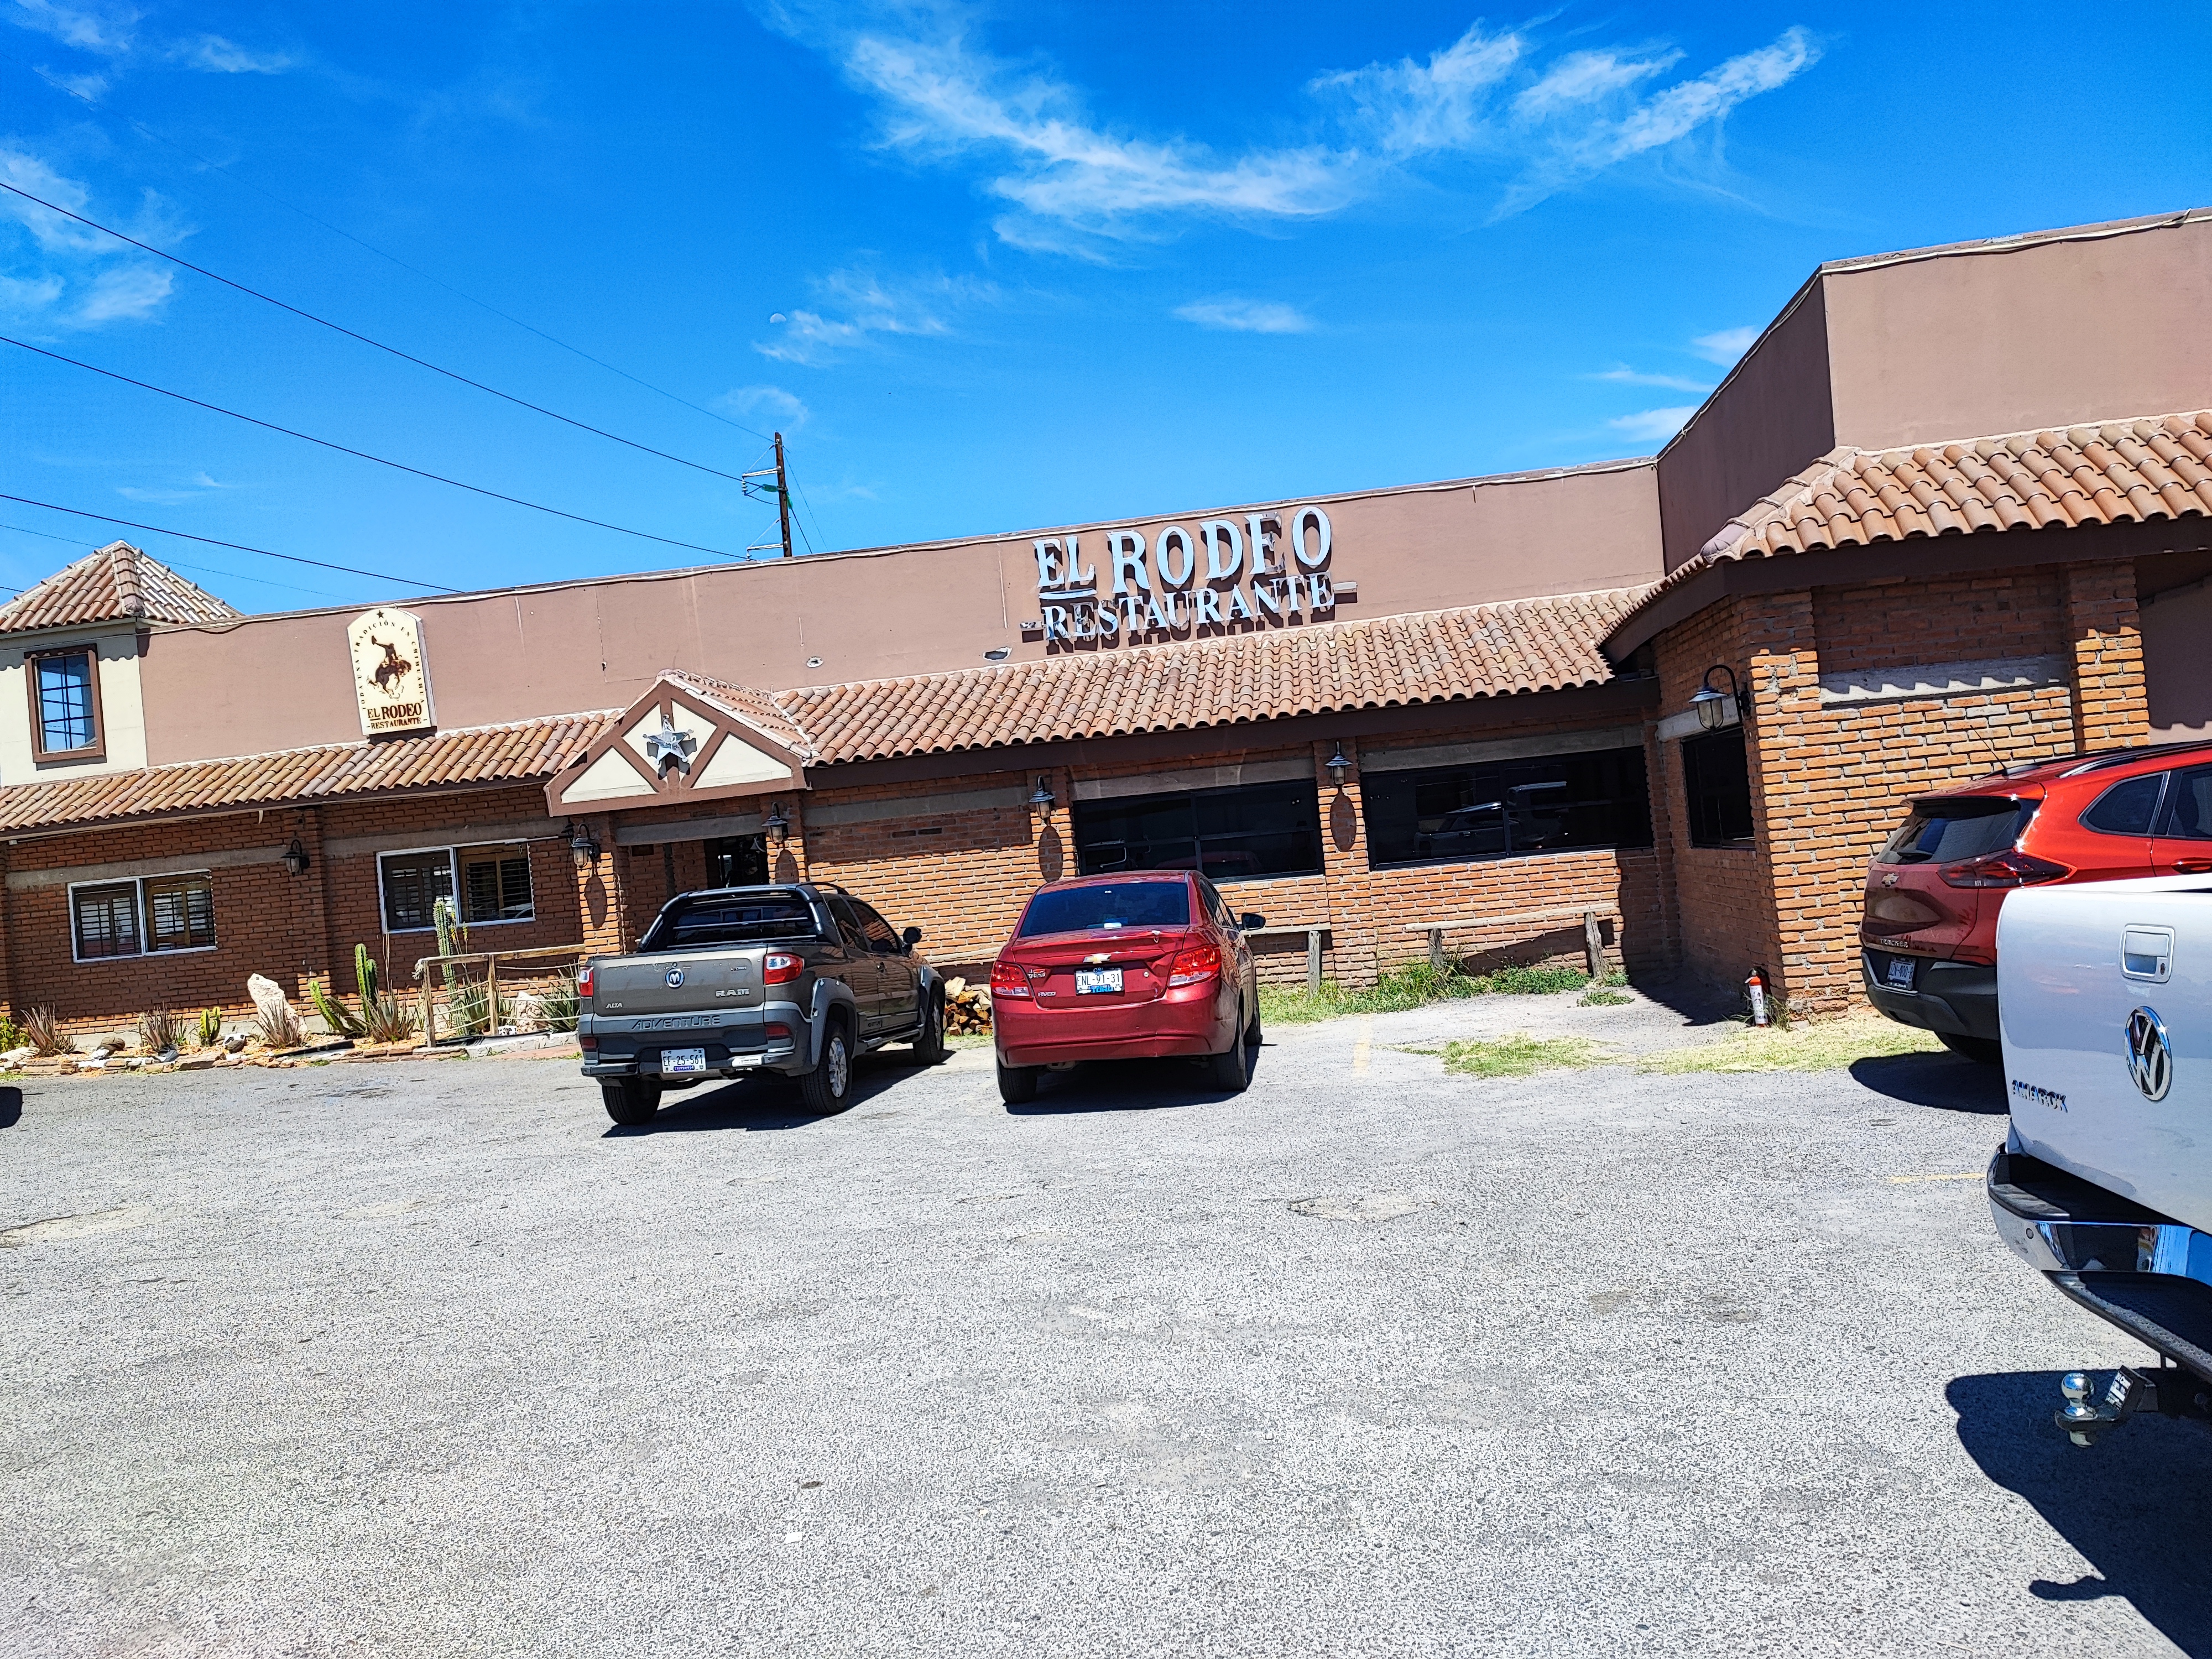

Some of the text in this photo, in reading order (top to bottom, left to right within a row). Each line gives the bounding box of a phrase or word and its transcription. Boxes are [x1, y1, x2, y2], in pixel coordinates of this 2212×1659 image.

[1032, 506, 1332, 594] EL RODEO
[1042, 571, 1335, 641] RESTAURANTE
[354, 619, 396, 653] TRADICIÓN
[411, 641, 425, 705] CHIHUAHUA
[367, 702, 422, 719] EL RODEO
[371, 717, 422, 729] RESTAURANTE
[1880, 938, 1908, 948] TRACKER
[1077, 973, 1120, 986] ENL-91-31
[716, 988, 750, 997] RAM
[631, 1015, 720, 1031] ADVENTURE
[662, 1054, 703, 1067] EF-25-561
[2012, 1079, 2068, 1113] AMAROK
